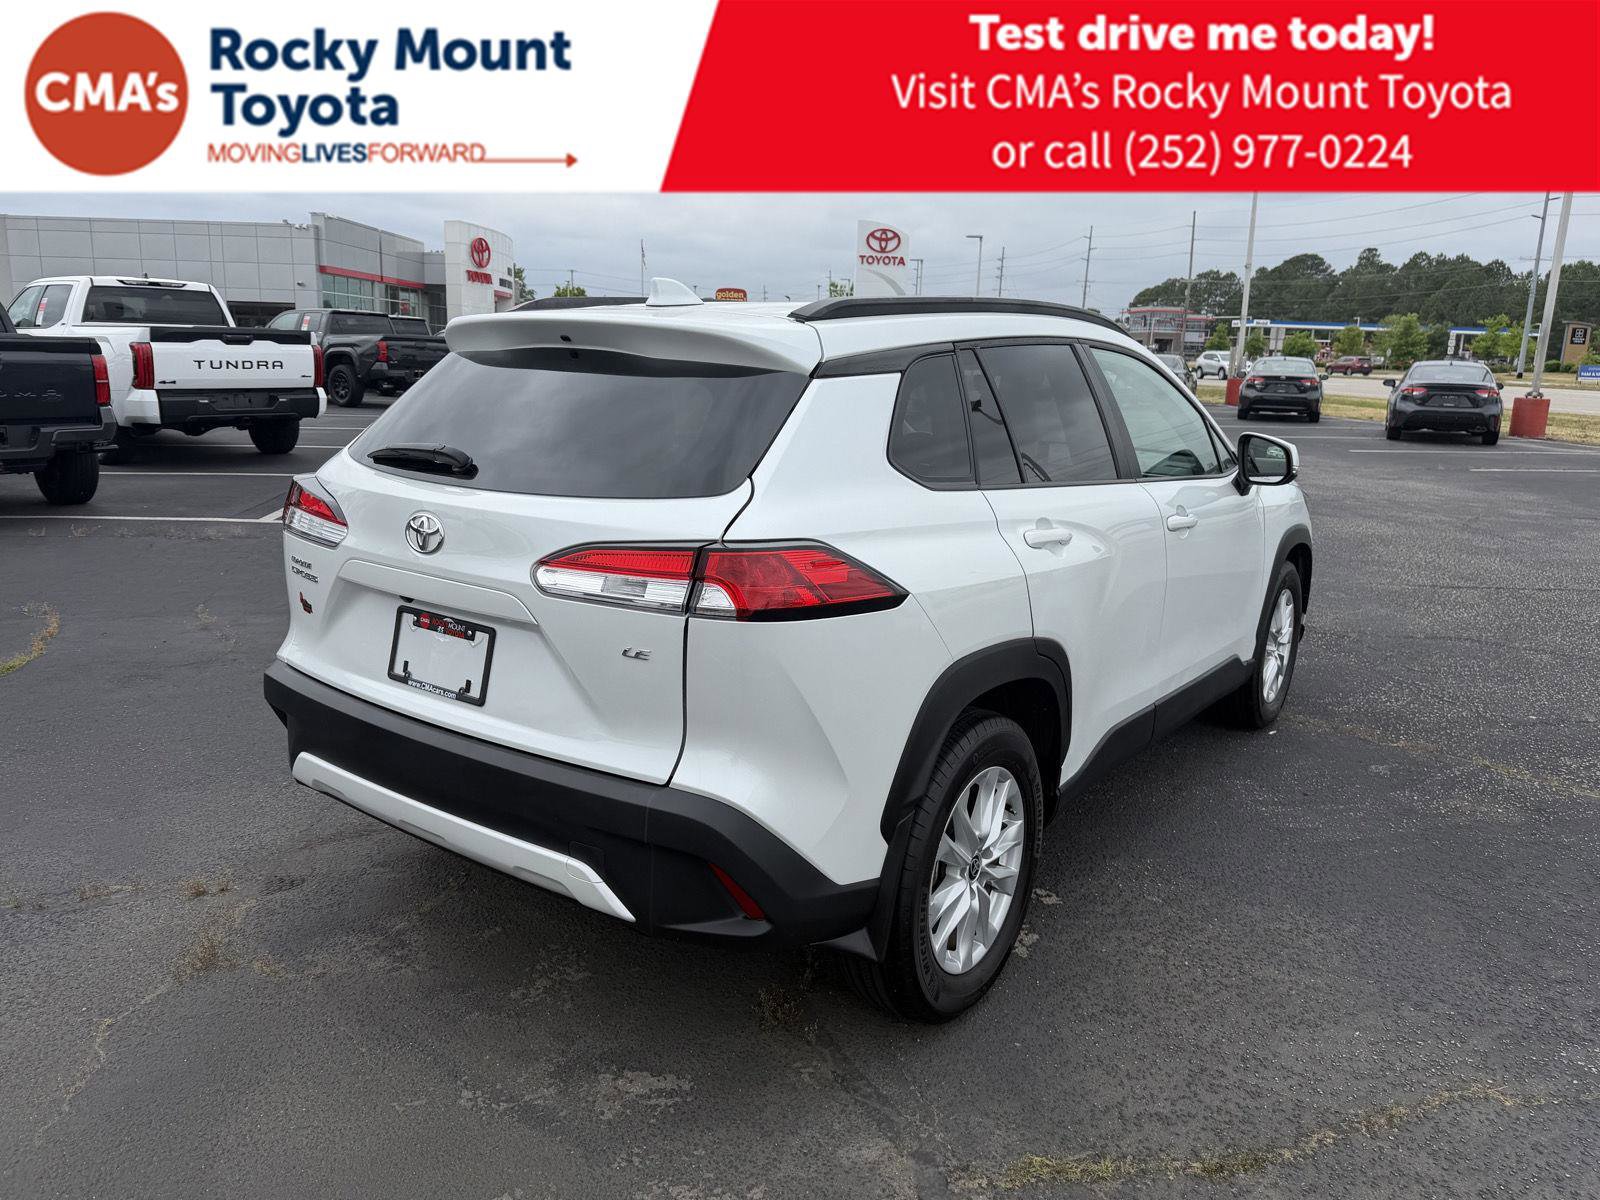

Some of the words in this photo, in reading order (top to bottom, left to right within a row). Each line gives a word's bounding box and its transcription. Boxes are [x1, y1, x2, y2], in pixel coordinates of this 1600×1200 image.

[859, 255, 906, 266] TOYOTA
[716, 291, 744, 300] golden
[193, 360, 284, 370] TUNDRA
[621, 647, 652, 661] LE
[408, 680, 457, 700] www.CMAcars.com
